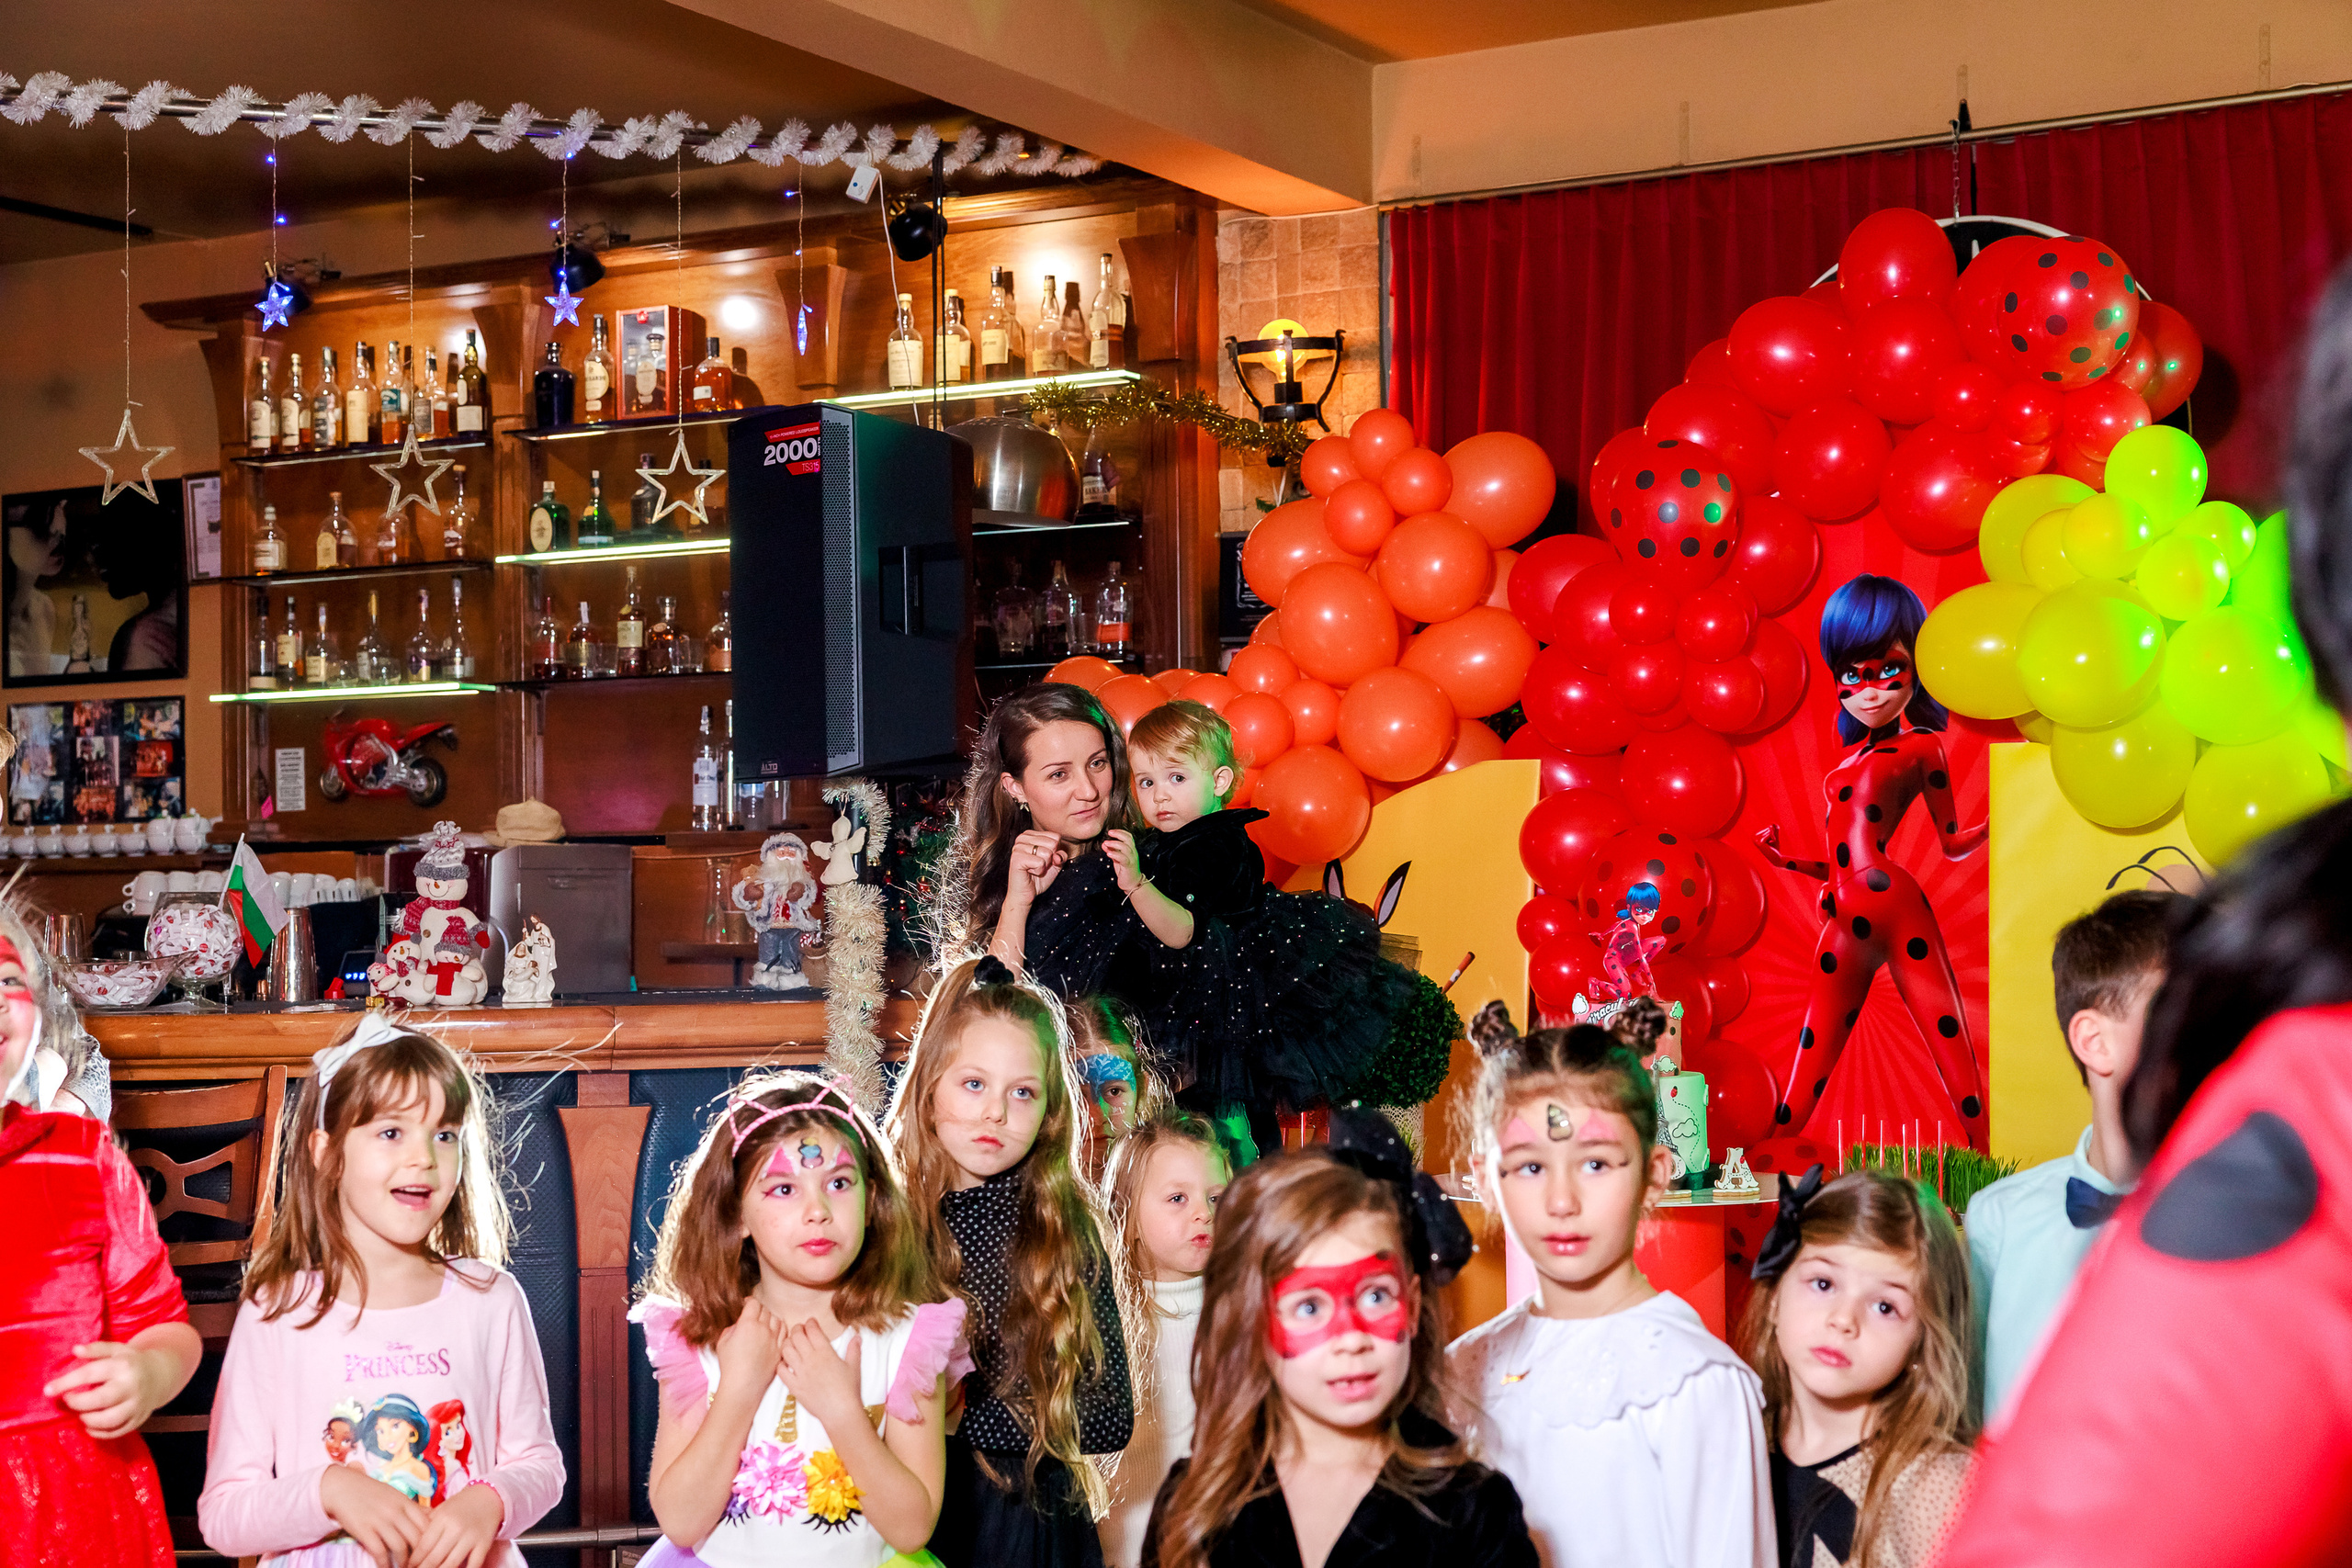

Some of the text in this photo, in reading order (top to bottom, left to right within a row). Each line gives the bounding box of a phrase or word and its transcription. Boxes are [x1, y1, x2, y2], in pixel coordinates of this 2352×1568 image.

[763, 437, 817, 466] 2000
[802, 461, 820, 472] TS315
[761, 762, 778, 771] ALTO
